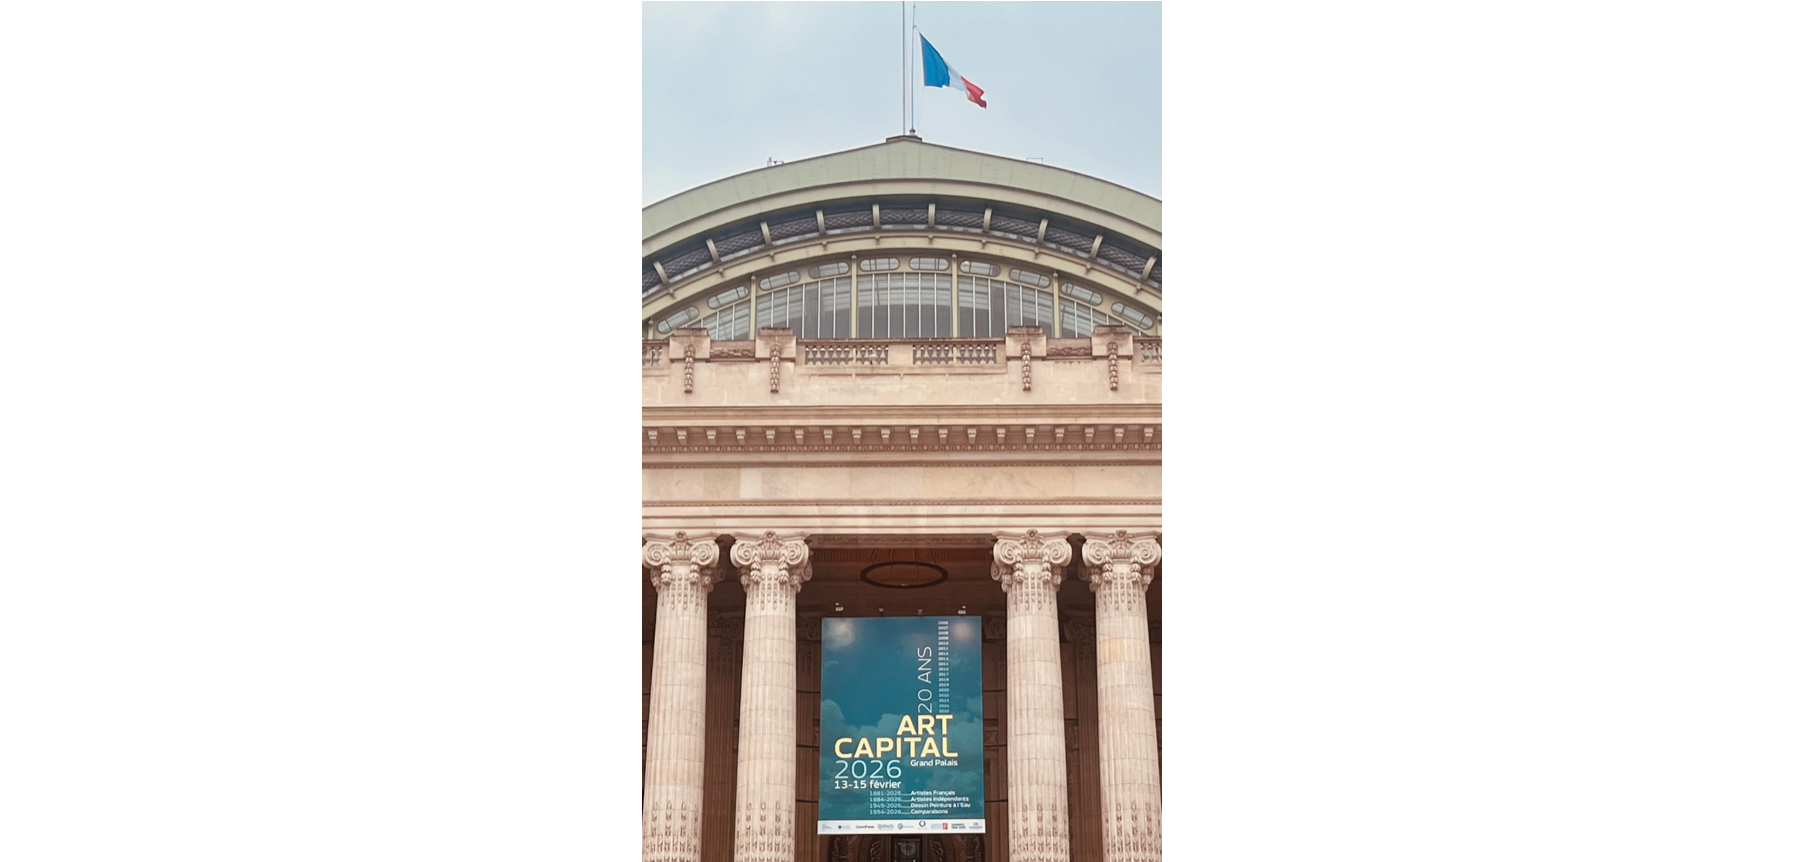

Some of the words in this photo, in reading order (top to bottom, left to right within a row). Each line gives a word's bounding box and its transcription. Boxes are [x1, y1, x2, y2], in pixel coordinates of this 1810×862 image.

[918, 646, 932, 683] ANS
[918, 689, 932, 713] 20
[896, 714, 953, 735] ART
[834, 736, 958, 759] CAPITAL
[835, 760, 902, 779] 2026
[834, 780, 866, 789] 13-15
[870, 780, 901, 789] février
